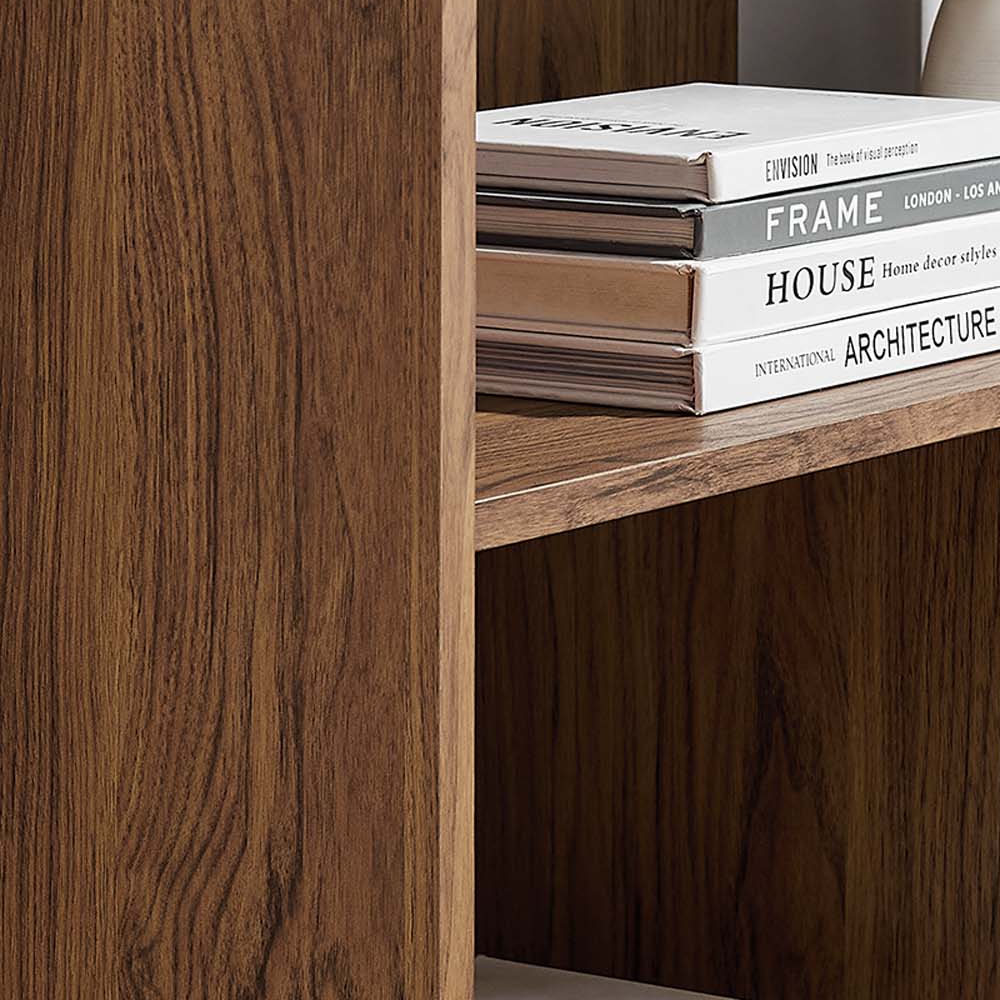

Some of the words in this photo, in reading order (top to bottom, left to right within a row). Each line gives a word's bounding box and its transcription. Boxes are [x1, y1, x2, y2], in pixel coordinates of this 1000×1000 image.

[765, 152, 819, 183] ENVISION
[826, 152, 839, 167] The
[765, 190, 883, 241] FRAME
[904, 188, 952, 209] LONDON
[963, 182, 984, 201] LOS
[765, 256, 876, 306] HOUSE
[882, 262, 920, 279] Home
[923, 254, 957, 272] decor
[754, 348, 837, 378] INTERNATIONAL
[844, 306, 998, 368] ARCHITECTURE
